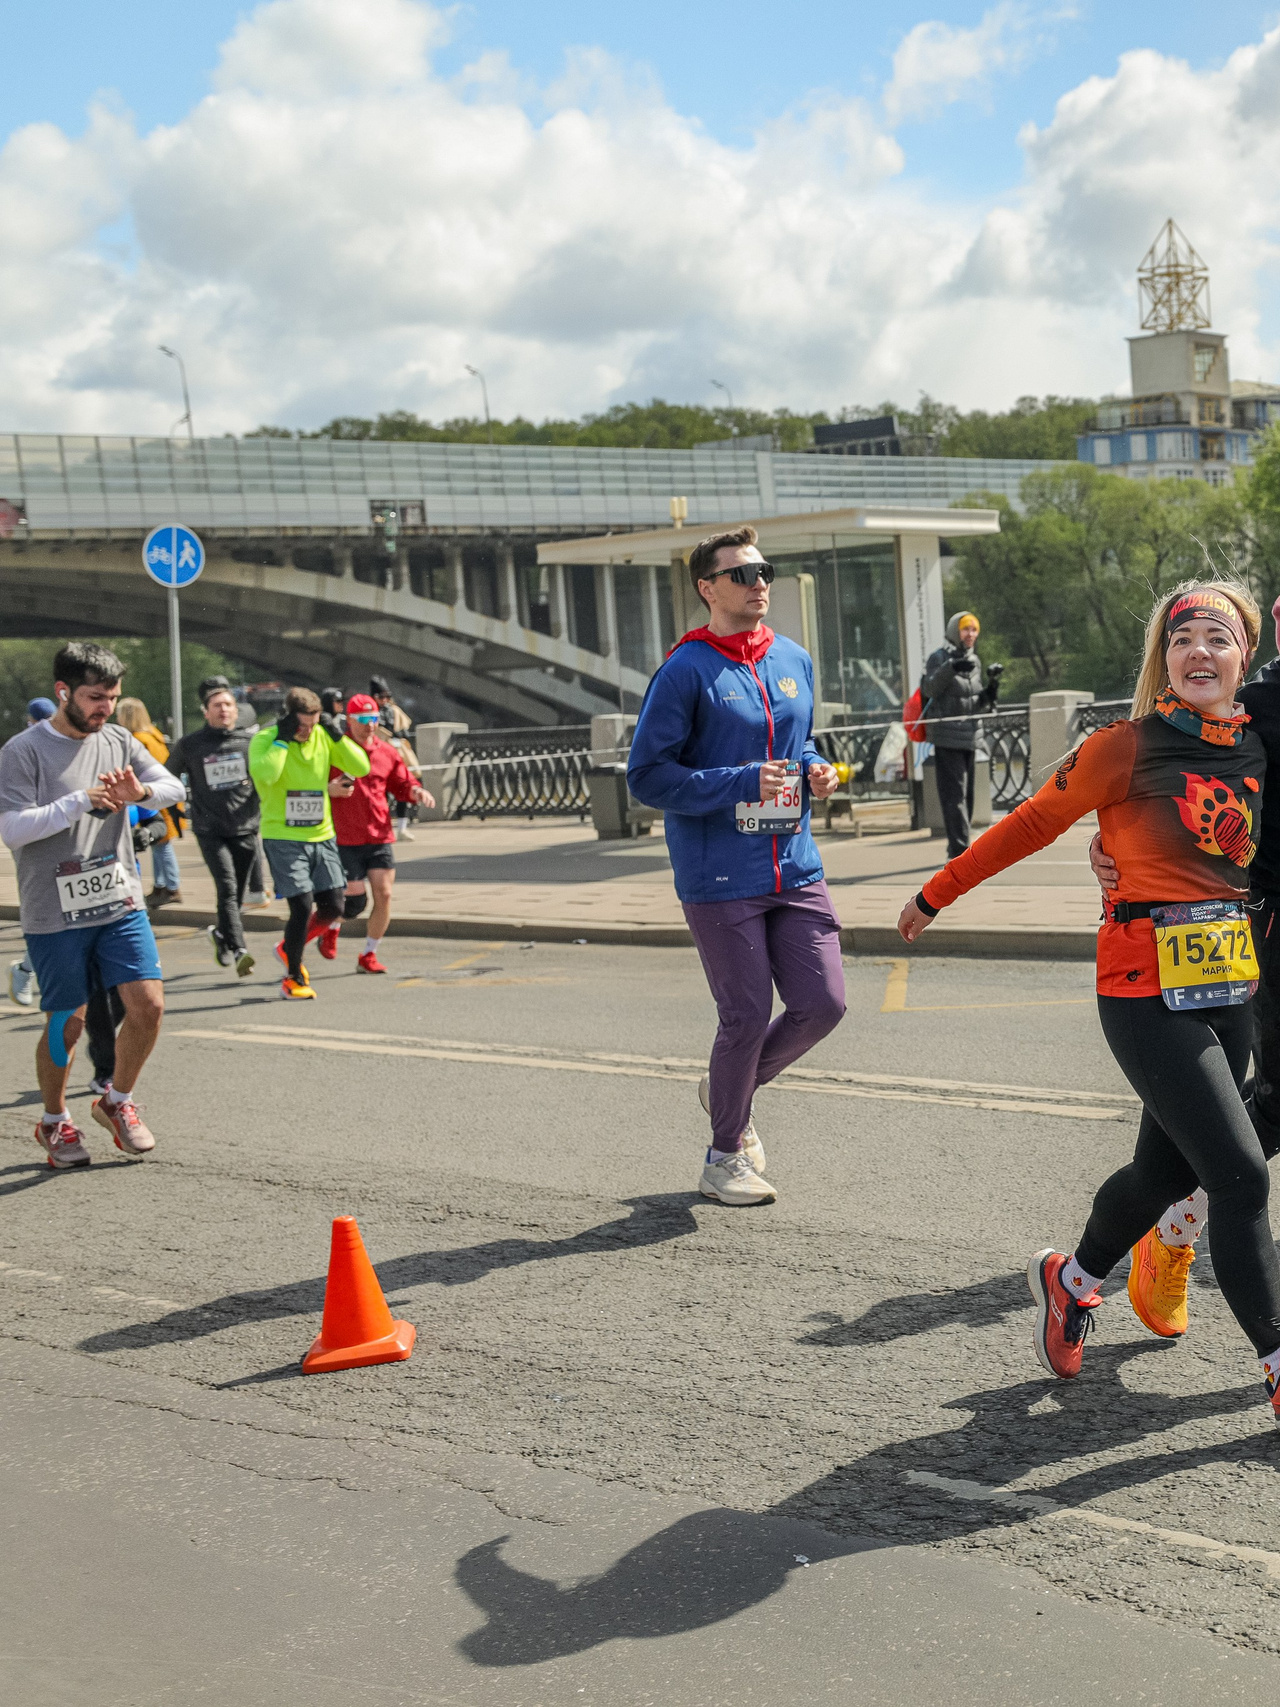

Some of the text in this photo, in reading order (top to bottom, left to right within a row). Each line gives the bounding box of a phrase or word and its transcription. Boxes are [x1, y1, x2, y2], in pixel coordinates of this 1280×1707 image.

[746, 817, 756, 830] G
[64, 870, 125, 899] 13824
[70, 910, 80, 921] F
[1166, 930, 1251, 966] 15272
[1202, 965, 1233, 976] МАРИЯ
[1173, 988, 1185, 1006] F
